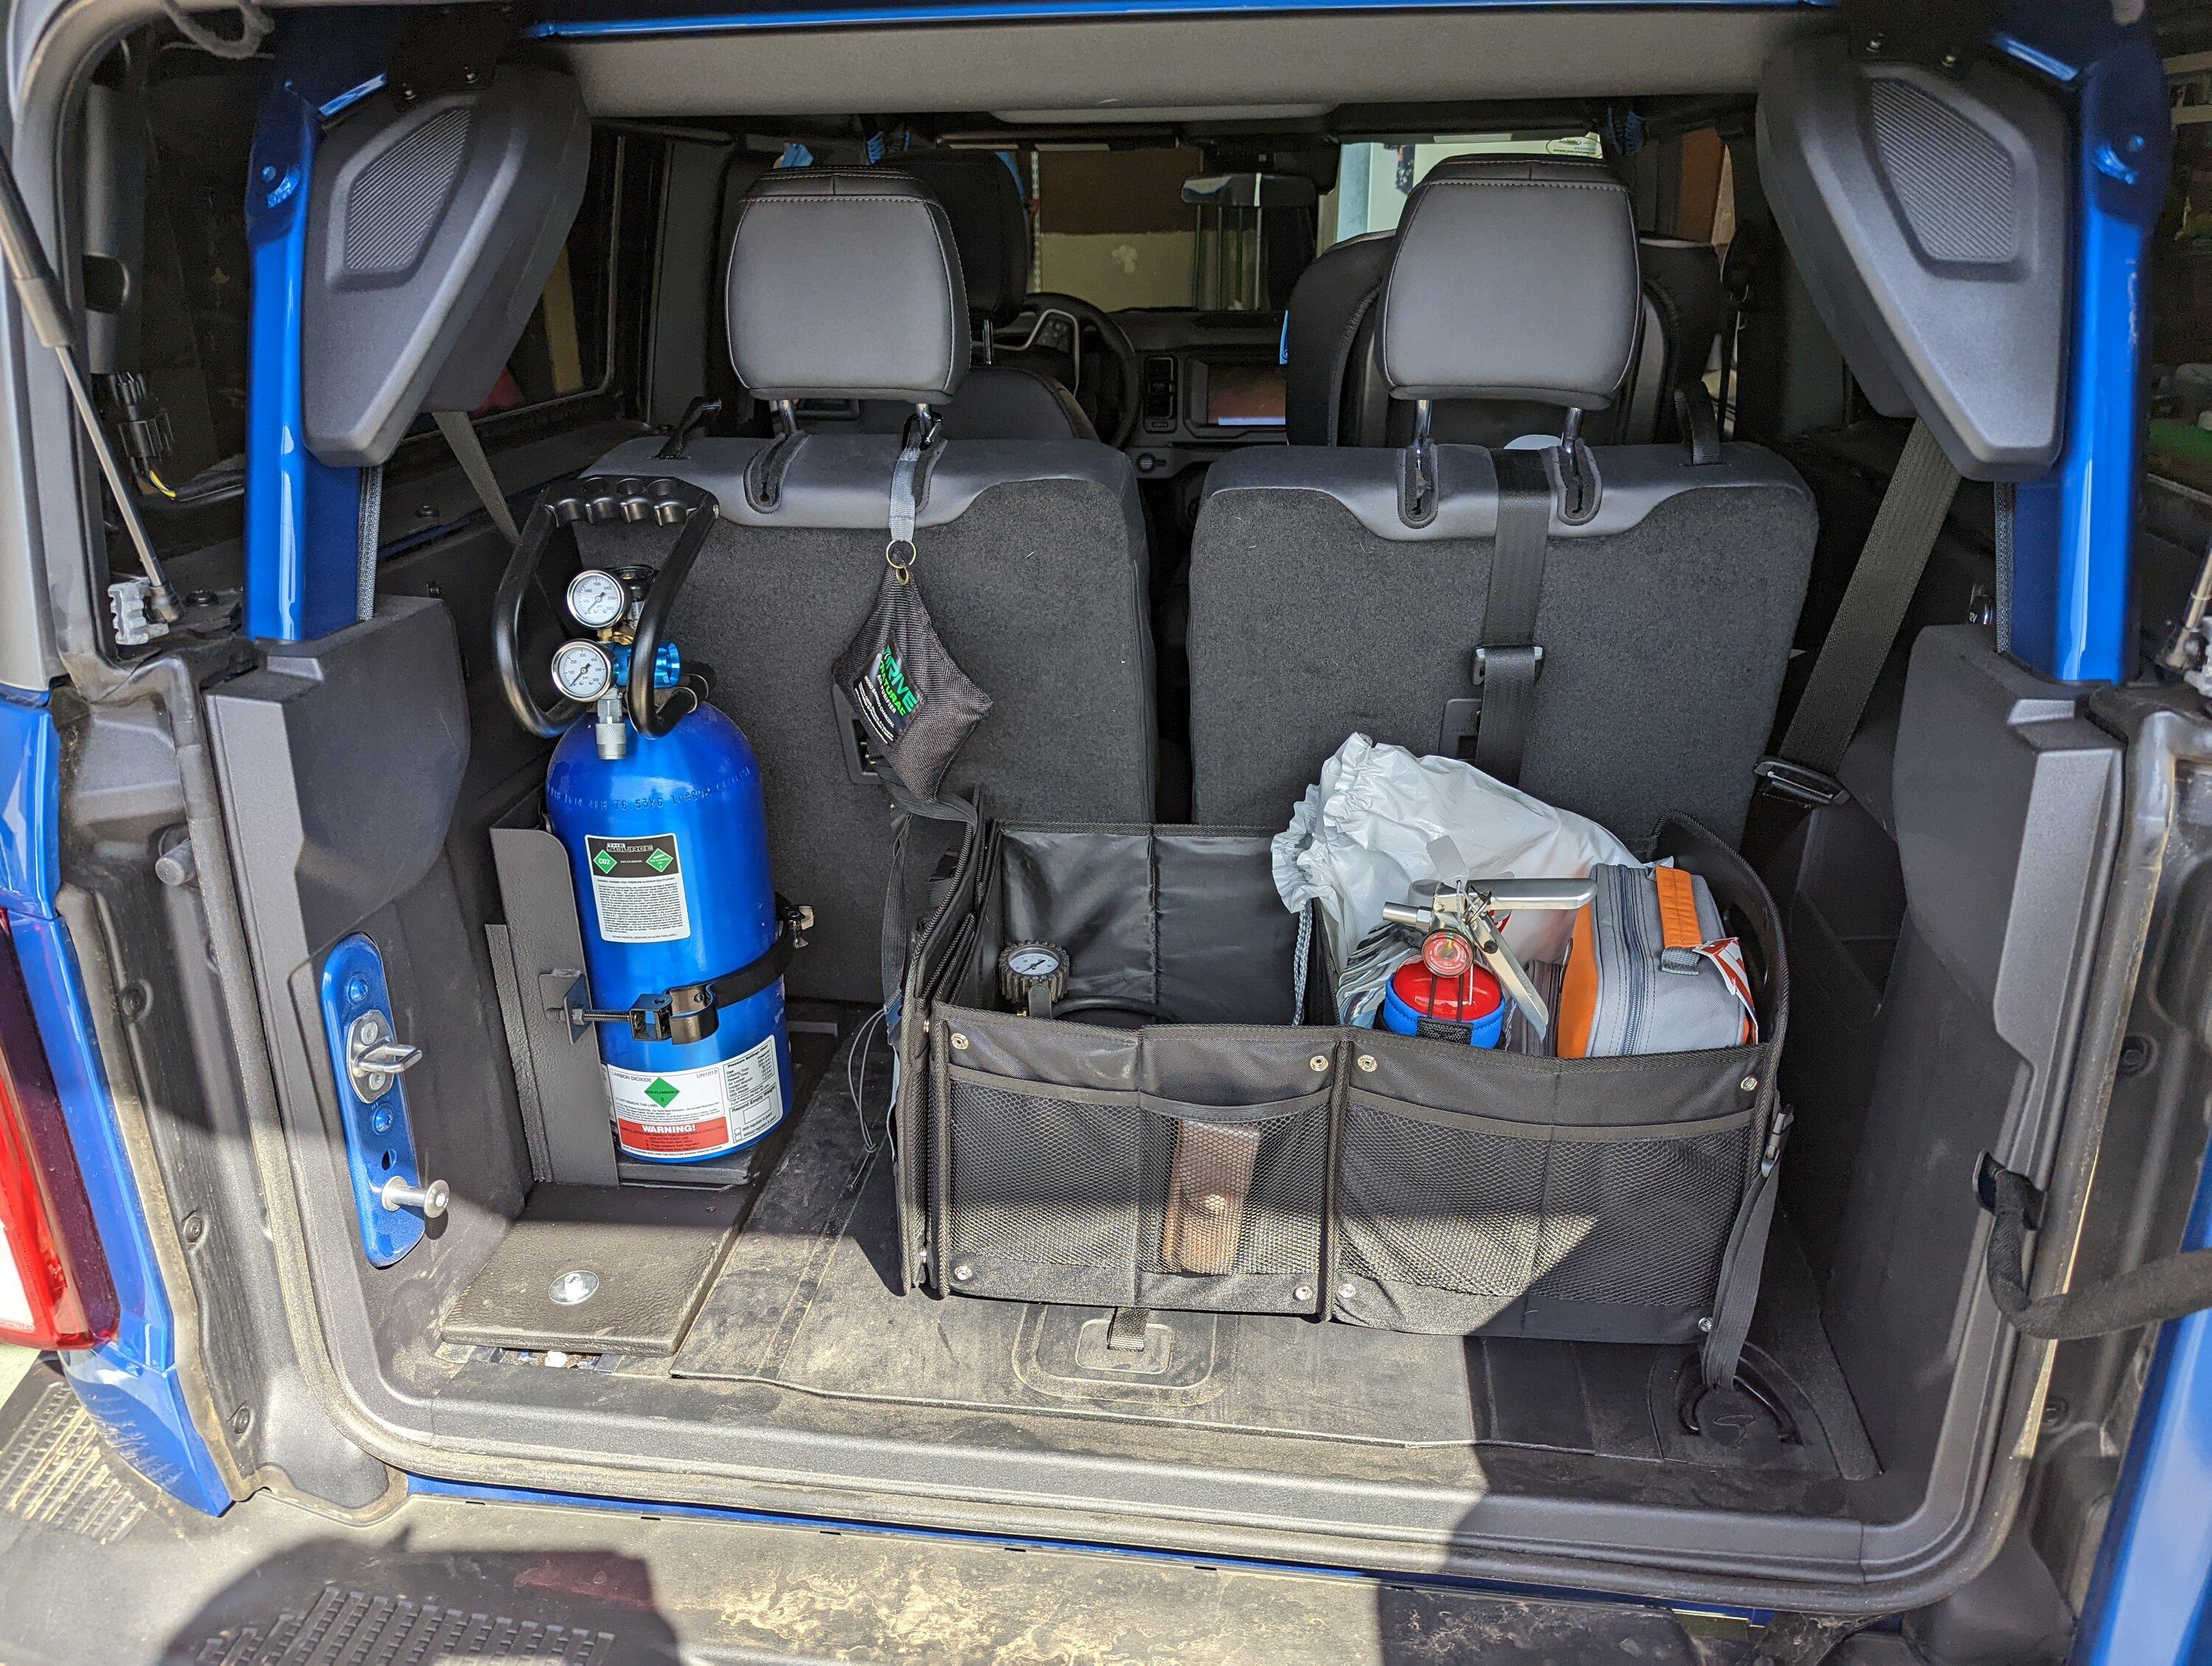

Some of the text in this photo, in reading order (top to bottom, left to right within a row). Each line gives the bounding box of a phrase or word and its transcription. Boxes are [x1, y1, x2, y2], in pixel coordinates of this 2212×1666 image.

[880, 685, 897, 714] PURIFIER
[880, 706, 895, 729] CHARCOAL
[612, 1072, 630, 1080] CARBON
[697, 1070, 717, 1078] UN1013
[732, 1103, 749, 1112] Record
[750, 1095, 763, 1105] Empty
[641, 1123, 696, 1134] WARNING!
